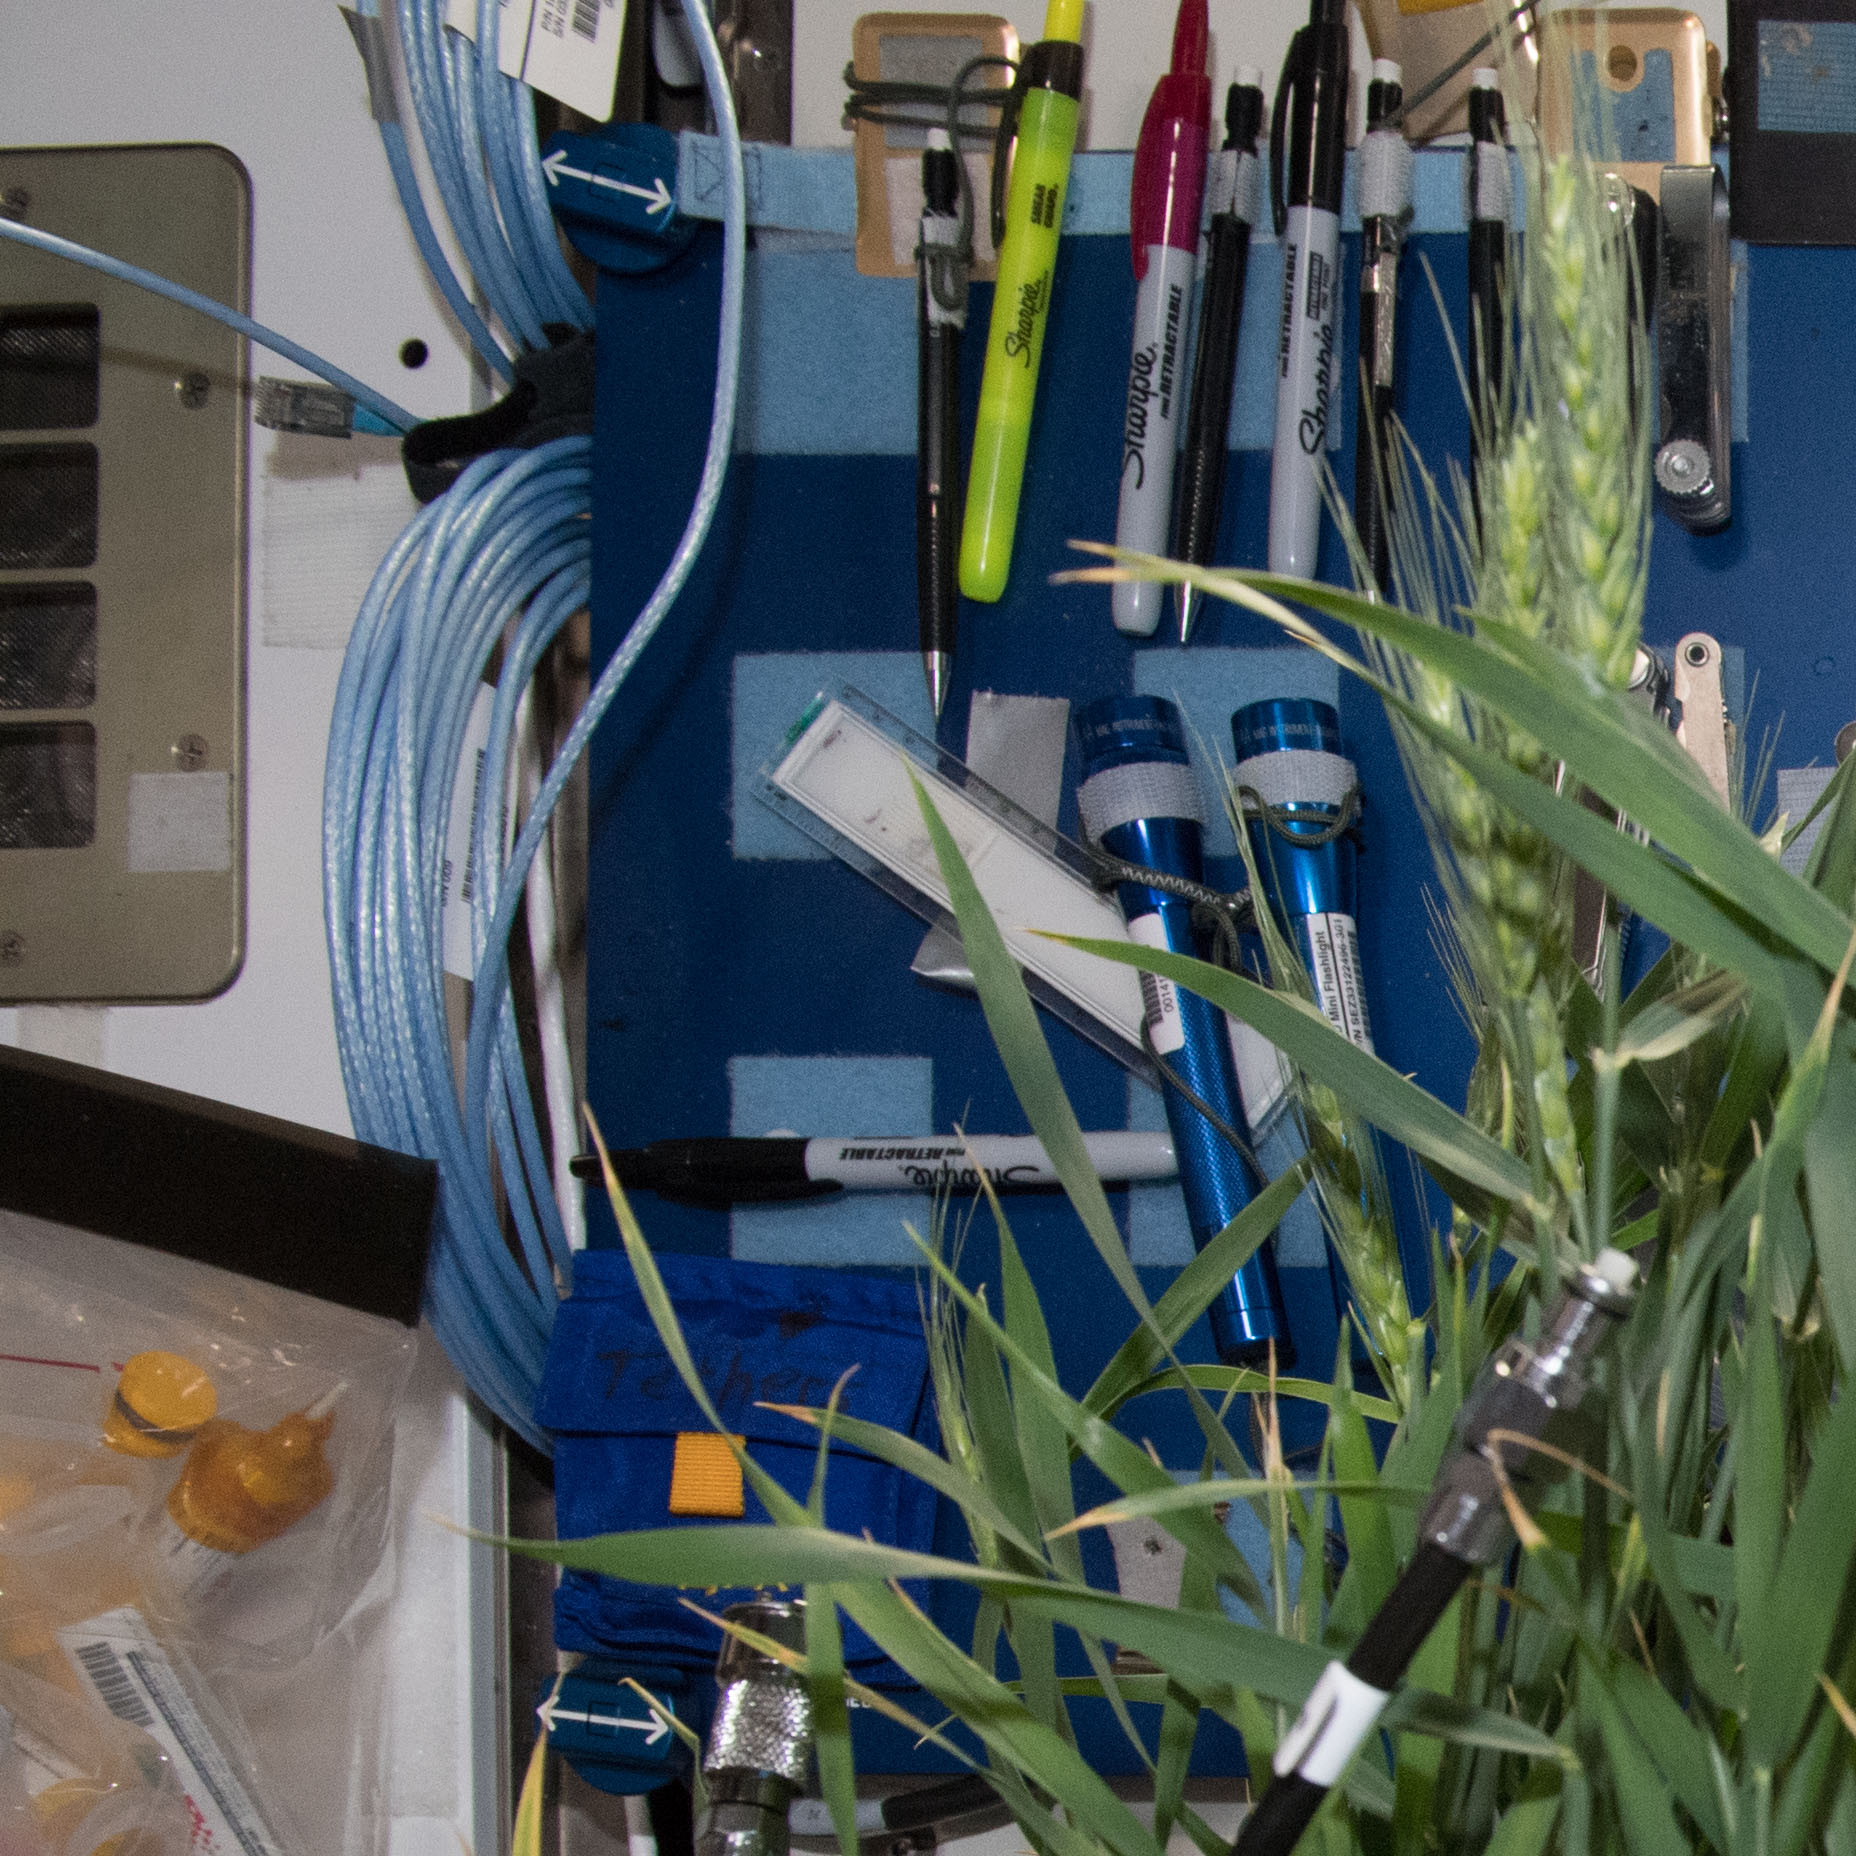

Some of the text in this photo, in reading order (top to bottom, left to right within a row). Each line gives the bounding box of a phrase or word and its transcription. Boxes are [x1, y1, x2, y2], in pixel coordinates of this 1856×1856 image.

[1006, 279, 1041, 369] Sharpie
[1160, 284, 1182, 398] RETRACTABLE
[1280, 244, 1297, 354] RETRACTABLE
[1315, 932, 1339, 1020] Mini Flashlight
[1353, 1030, 1362, 1042] /N
[840, 1148, 943, 1161] RETRACTABLE
